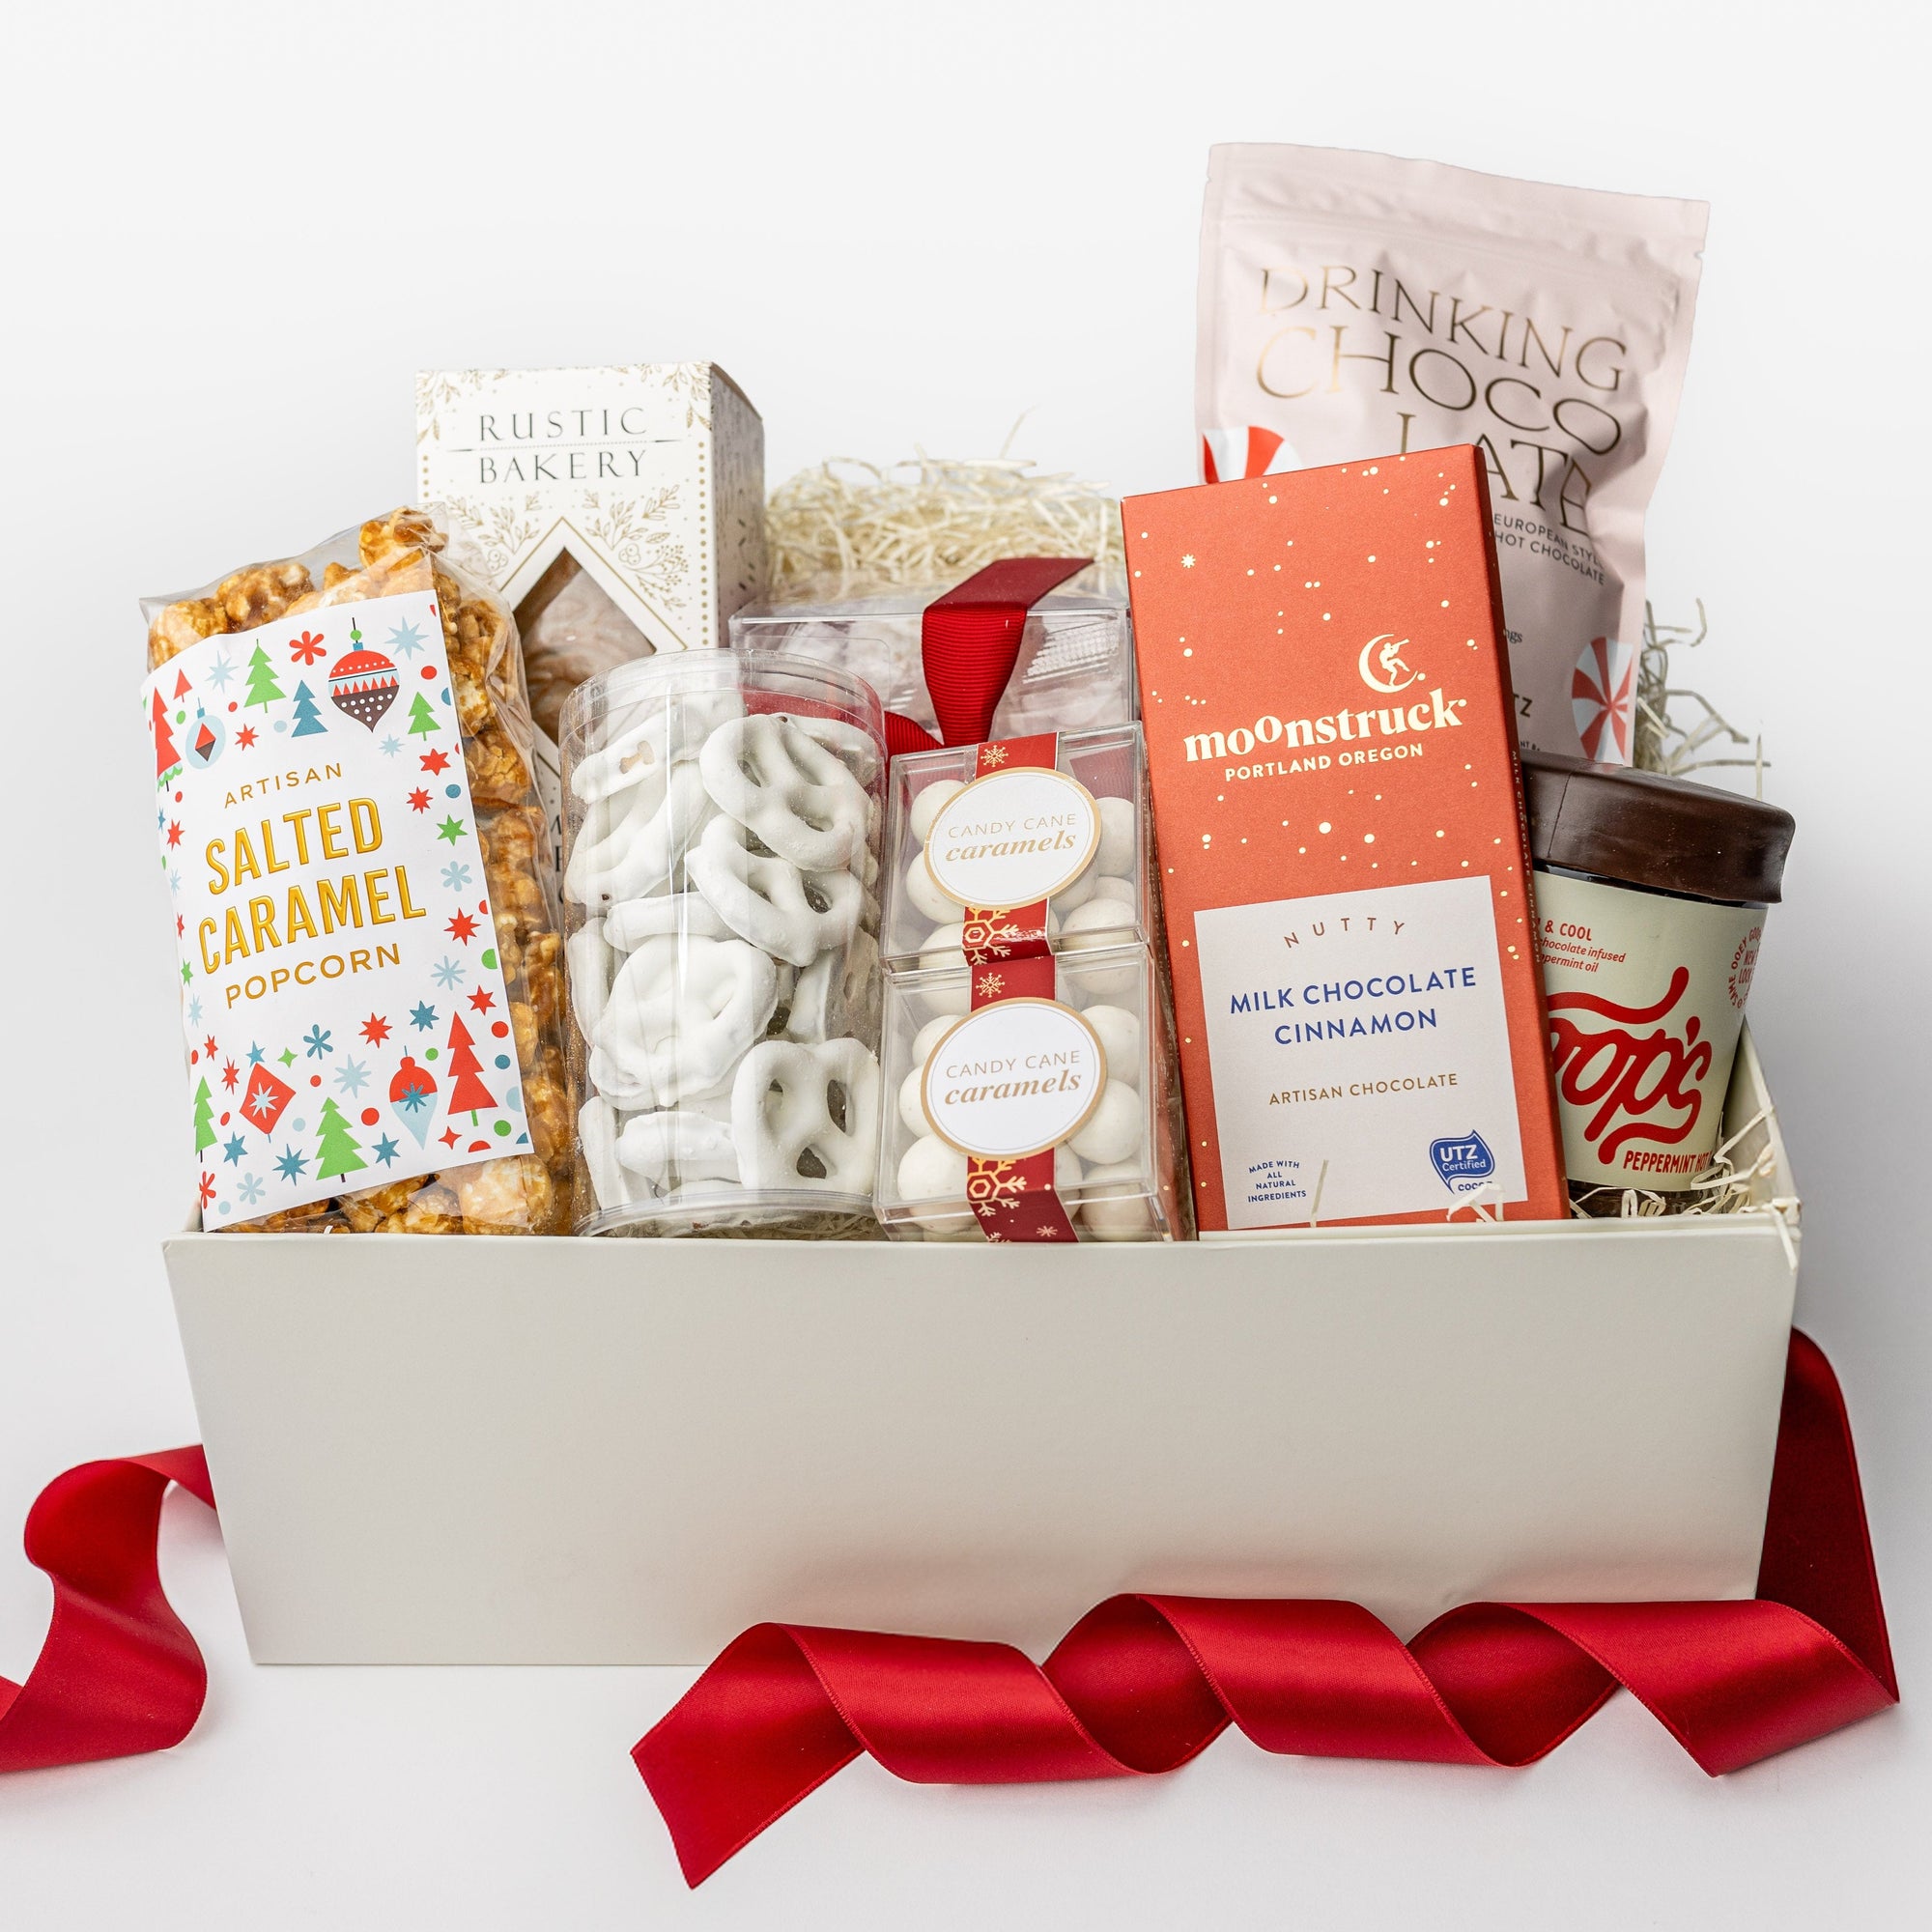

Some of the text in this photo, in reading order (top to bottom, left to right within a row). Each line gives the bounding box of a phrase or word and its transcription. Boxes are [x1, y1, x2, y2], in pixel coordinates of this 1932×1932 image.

[1260, 265, 1627, 391] DRINKING
[1257, 325, 1622, 455] CHOCO
[479, 407, 647, 442] RUSTIC
[479, 449, 647, 484] BAKERY
[1493, 513, 1569, 551] EUROPEAN
[1493, 530, 1605, 584] HOT CHOCOLATE
[1183, 688, 1466, 762] moonstruck
[1225, 743, 1424, 781] PORTLAND OREGON
[224, 762, 342, 809] ARTISAN
[948, 813, 1077, 838] CANDY CANE
[205, 797, 384, 895] SALTED
[945, 830, 1077, 862] caramels
[199, 865, 427, 975] CARAMEL
[1284, 917, 1405, 948] NUTTY
[1545, 920, 1553, 933] &
[1559, 923, 1592, 941] COOL
[1541, 937, 1626, 963] hocolate infused
[1585, 962, 1599, 972] oil
[225, 943, 401, 1009] POPCORN
[1231, 967, 1476, 1013] MILK CHOCOLATE
[1274, 1009, 1437, 1044] CINNAMON
[947, 1050, 1081, 1078] CANDY CANE
[945, 1069, 1082, 1105] caramels
[1269, 1073, 1458, 1105] ARTISAN CHOCOLATE
[1248, 1161, 1273, 1174] MADE
[1440, 1145, 1478, 1162] UTZ
[1442, 1159, 1487, 1172] Certified
[1623, 1151, 1696, 1174] PEPPERMINT
[1248, 1190, 1307, 1203] INGREDIENTS
[1256, 1179, 1296, 1189] NATURAL
